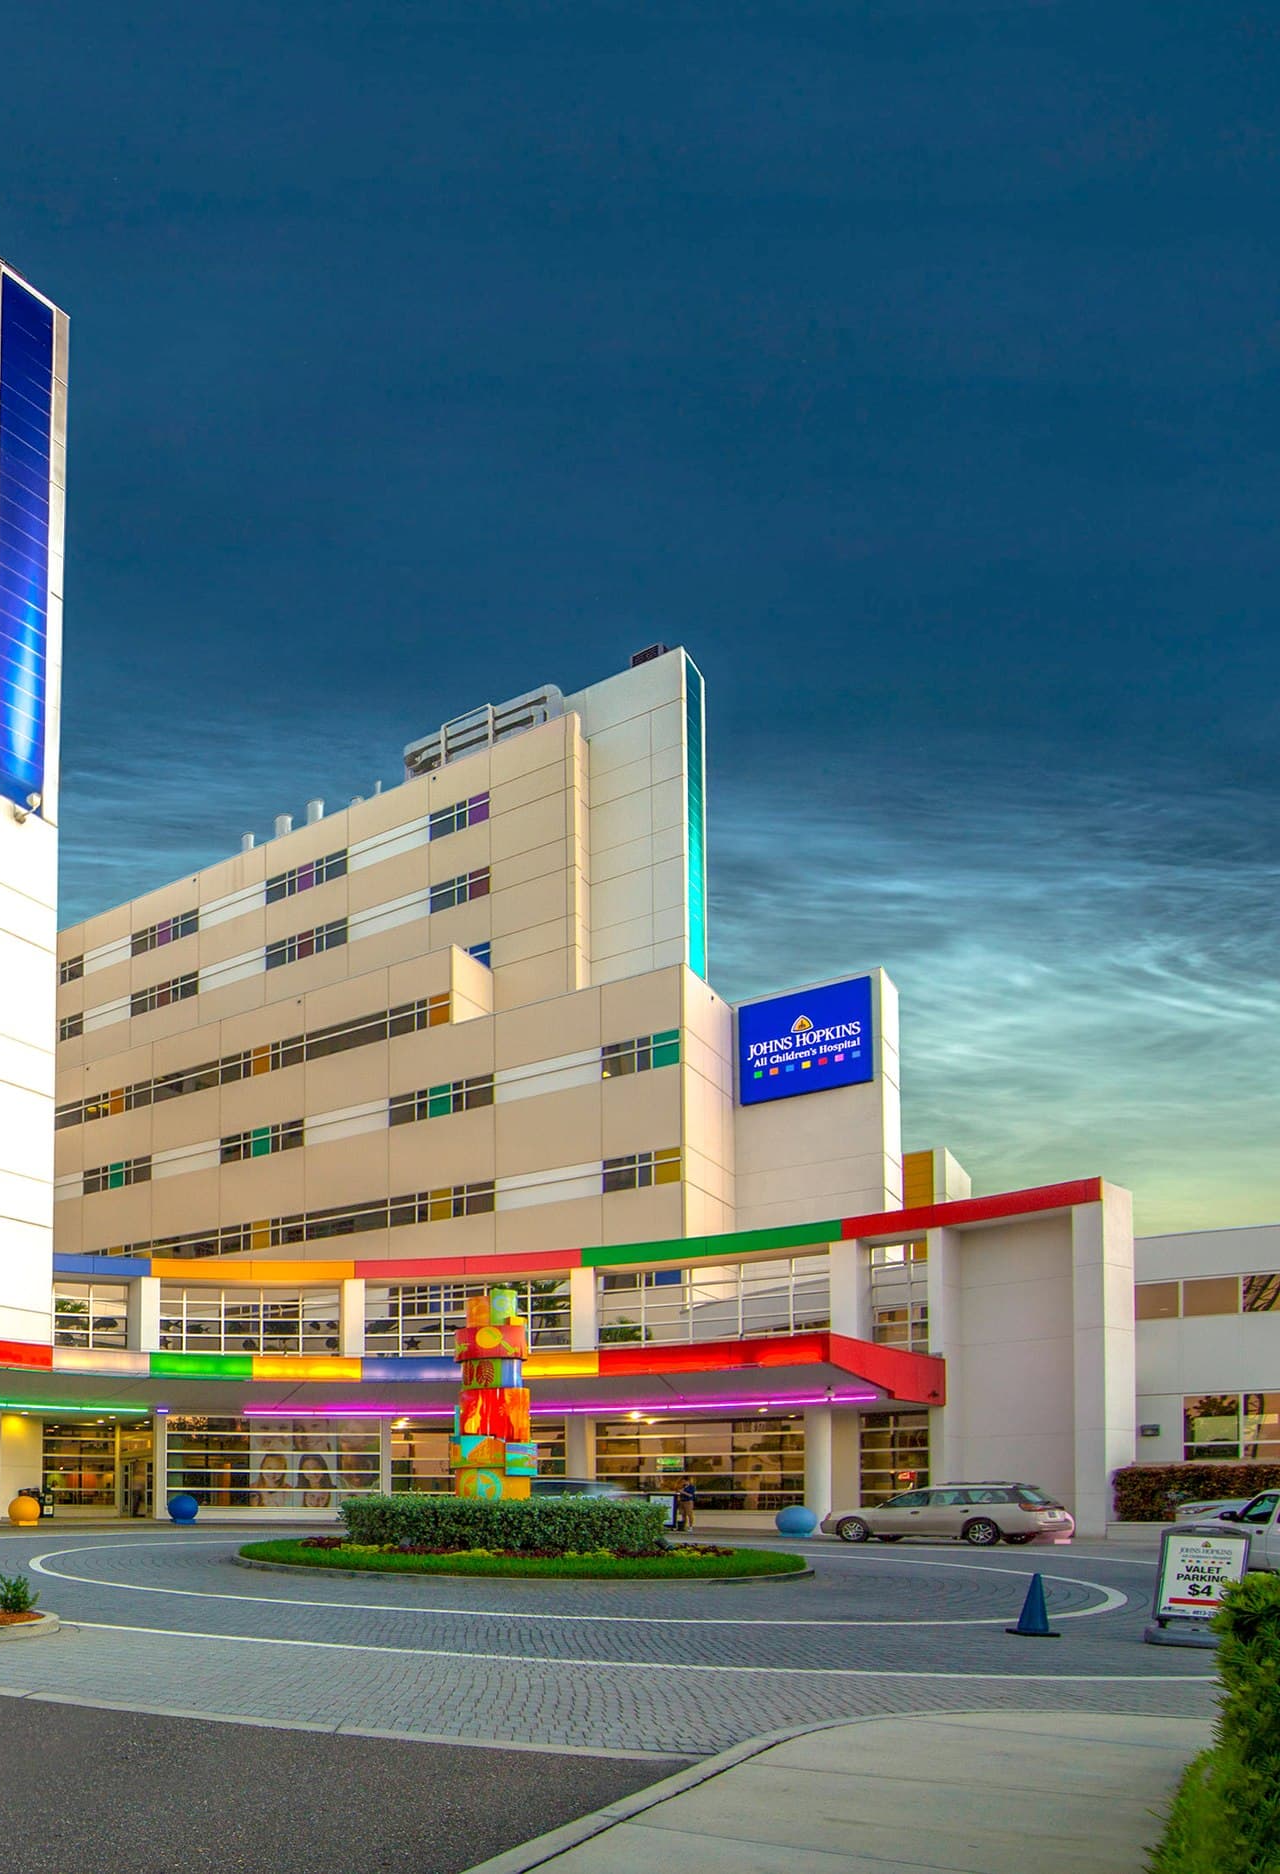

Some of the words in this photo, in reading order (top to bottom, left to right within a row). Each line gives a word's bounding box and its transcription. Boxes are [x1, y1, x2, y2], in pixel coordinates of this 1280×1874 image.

[747, 1036, 793, 1061] JOHNS
[795, 1021, 861, 1048] HOPKINS
[754, 1055, 767, 1068] All
[770, 1047, 817, 1065] Children's
[819, 1037, 861, 1054] Hospital
[1185, 1565, 1222, 1574] VALET
[1187, 1583, 1212, 1597] $4
